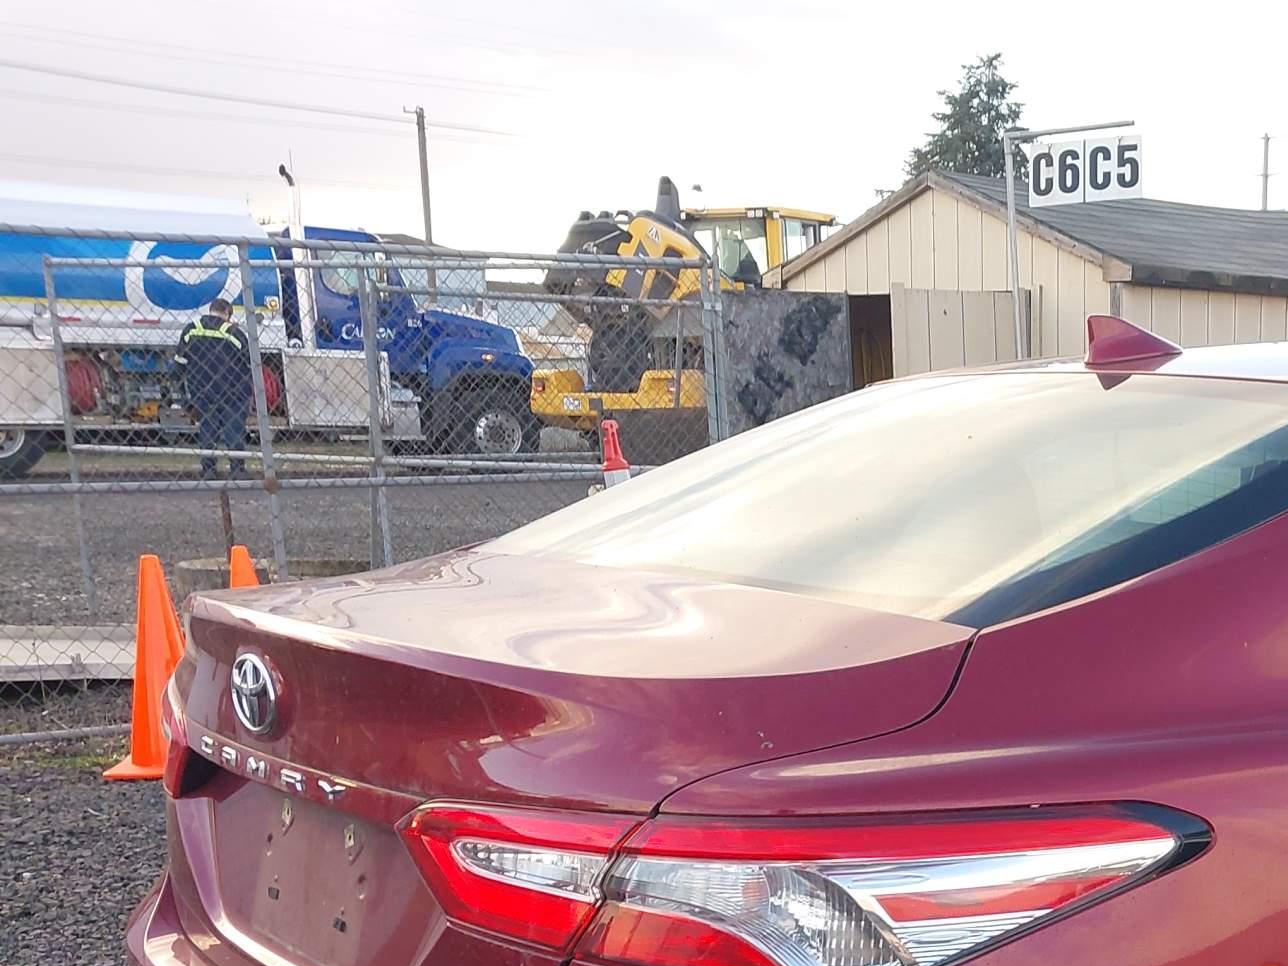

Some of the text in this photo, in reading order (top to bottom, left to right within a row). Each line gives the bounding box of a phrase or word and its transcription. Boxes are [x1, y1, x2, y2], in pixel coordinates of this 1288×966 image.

[1032, 149, 1080, 197] C6
[1089, 143, 1139, 190] C5
[200, 735, 346, 800] CAMRY
